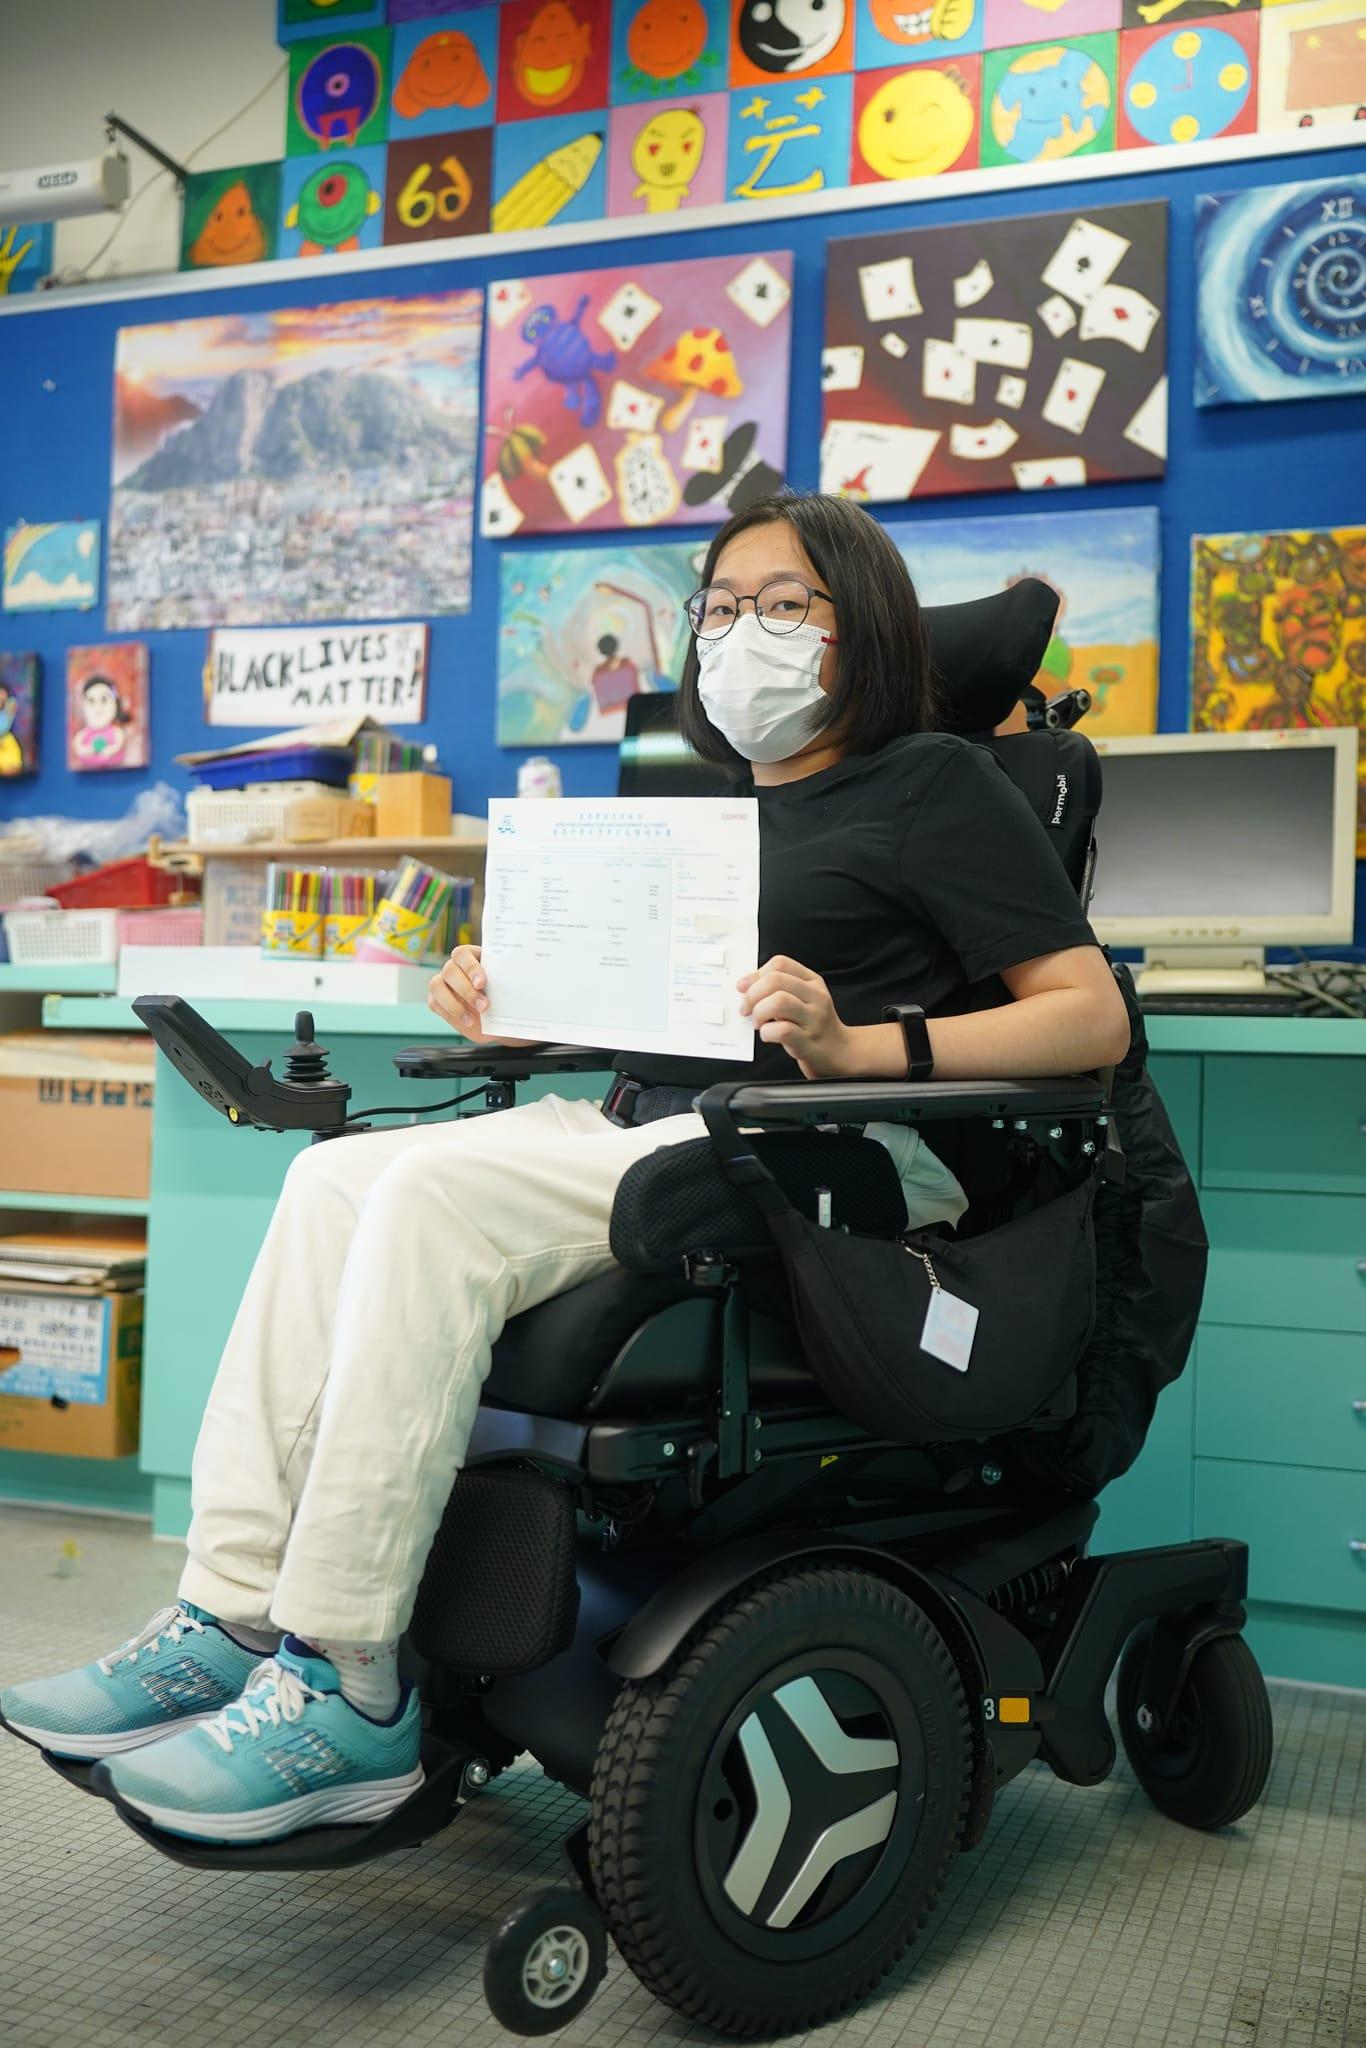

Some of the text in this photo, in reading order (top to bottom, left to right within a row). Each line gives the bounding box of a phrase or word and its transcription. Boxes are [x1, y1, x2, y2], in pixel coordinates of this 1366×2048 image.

[216, 634, 389, 694] BLACK LIVES
[1050, 773, 1068, 825] permobil
[983, 1698, 996, 1720] 3
